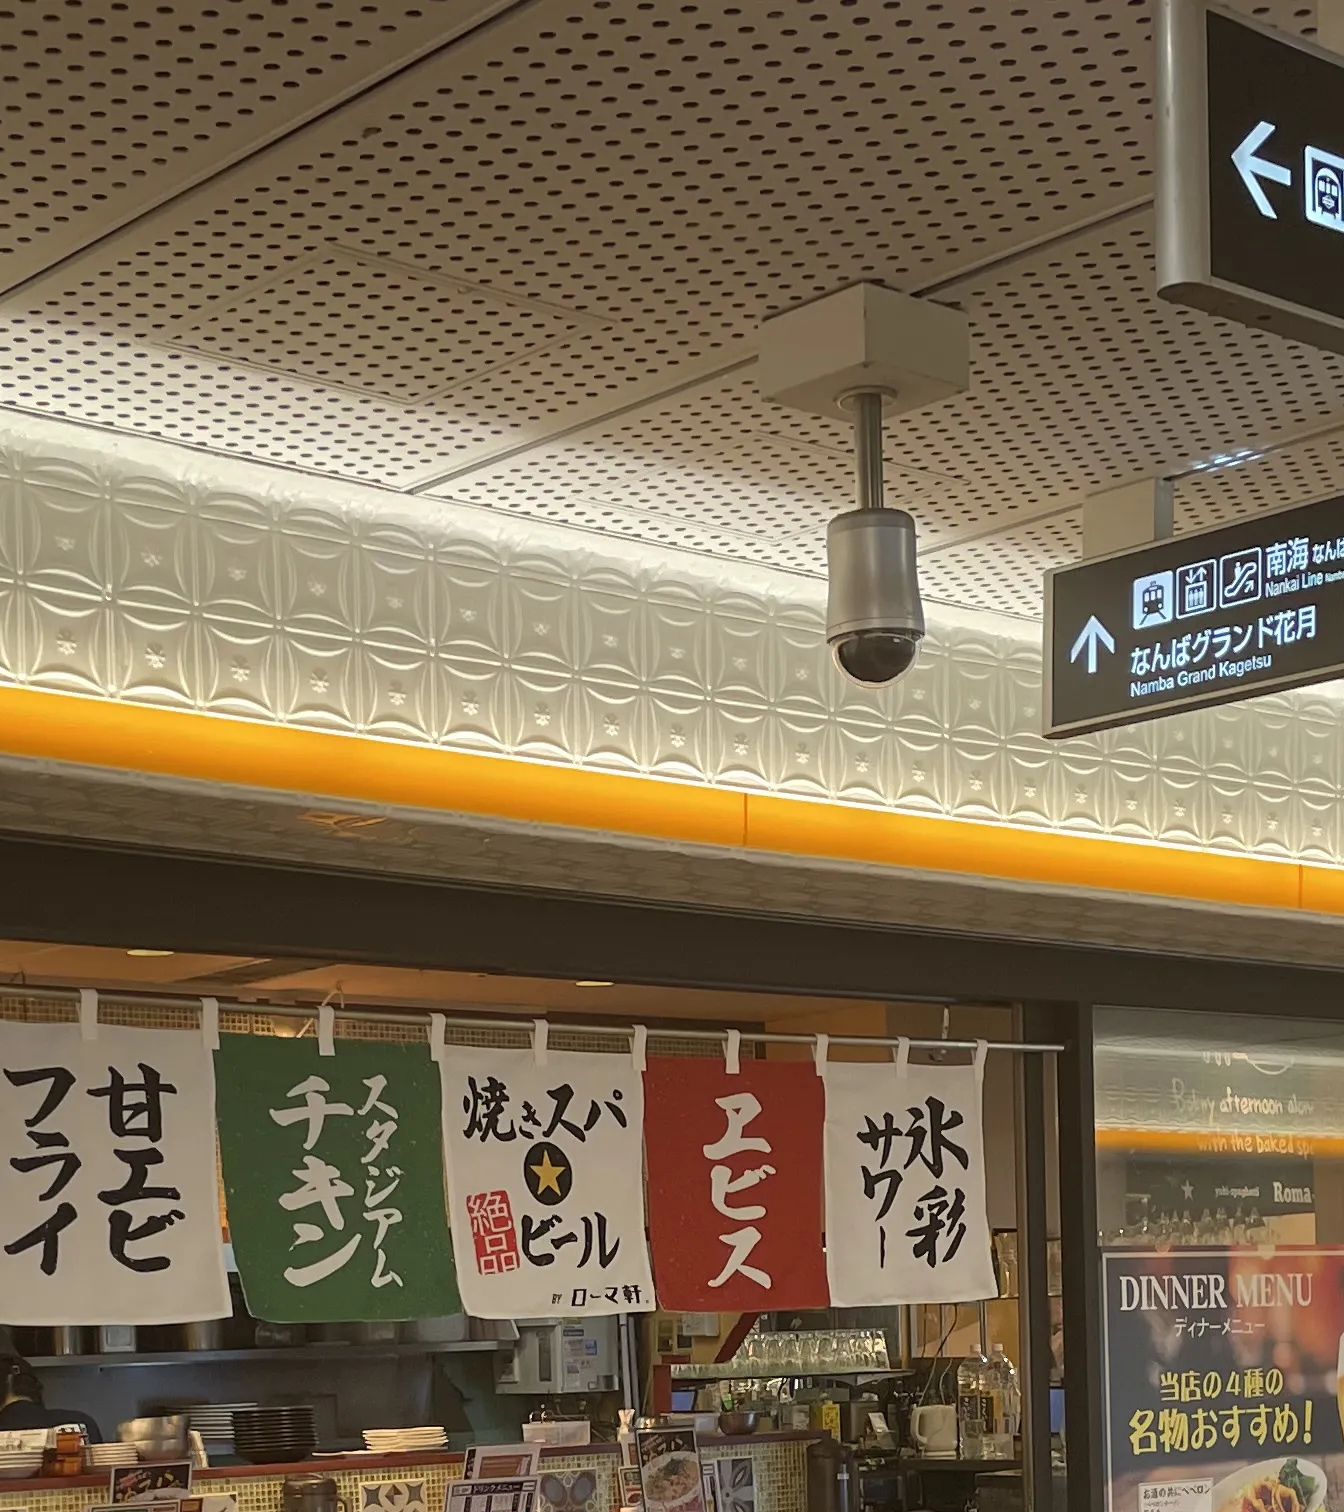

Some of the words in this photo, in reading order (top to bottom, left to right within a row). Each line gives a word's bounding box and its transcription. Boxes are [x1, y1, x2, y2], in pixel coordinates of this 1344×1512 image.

[1265, 536, 1309, 579] 南海
[1265, 573, 1300, 598] Nankai
[1301, 570, 1324, 590] Line
[1130, 604, 1317, 676] なんばグランド花月
[1129, 671, 1175, 699] Namba
[1176, 661, 1217, 687] Grand
[1218, 652, 1273, 683] Kagetsu
[461, 1075, 629, 1144] 焼きスパ
[1219, 1087, 1283, 1116] afternoon
[2, 1065, 82, 1277] フライ
[86, 1062, 186, 1274] 甘エビ
[1230, 1129, 1254, 1153] the
[1256, 1131, 1294, 1155] baked
[268, 1074, 364, 1288] チキン
[355, 1073, 404, 1290] スタジアム
[856, 1110, 907, 1270] サワー
[901, 1095, 971, 1270] 氷彩
[465, 1189, 522, 1276] 絶品
[519, 1210, 622, 1271] ビール
[571, 1284, 643, 1307] ローマ軒
[1119, 1274, 1228, 1311] DINNER
[1236, 1272, 1314, 1308] MENU
[1174, 1317, 1266, 1338] ディナーメニュー
[1160, 1368, 1284, 1402] 当店の4種の
[1128, 1399, 1314, 1456] 名物おすすめ!
